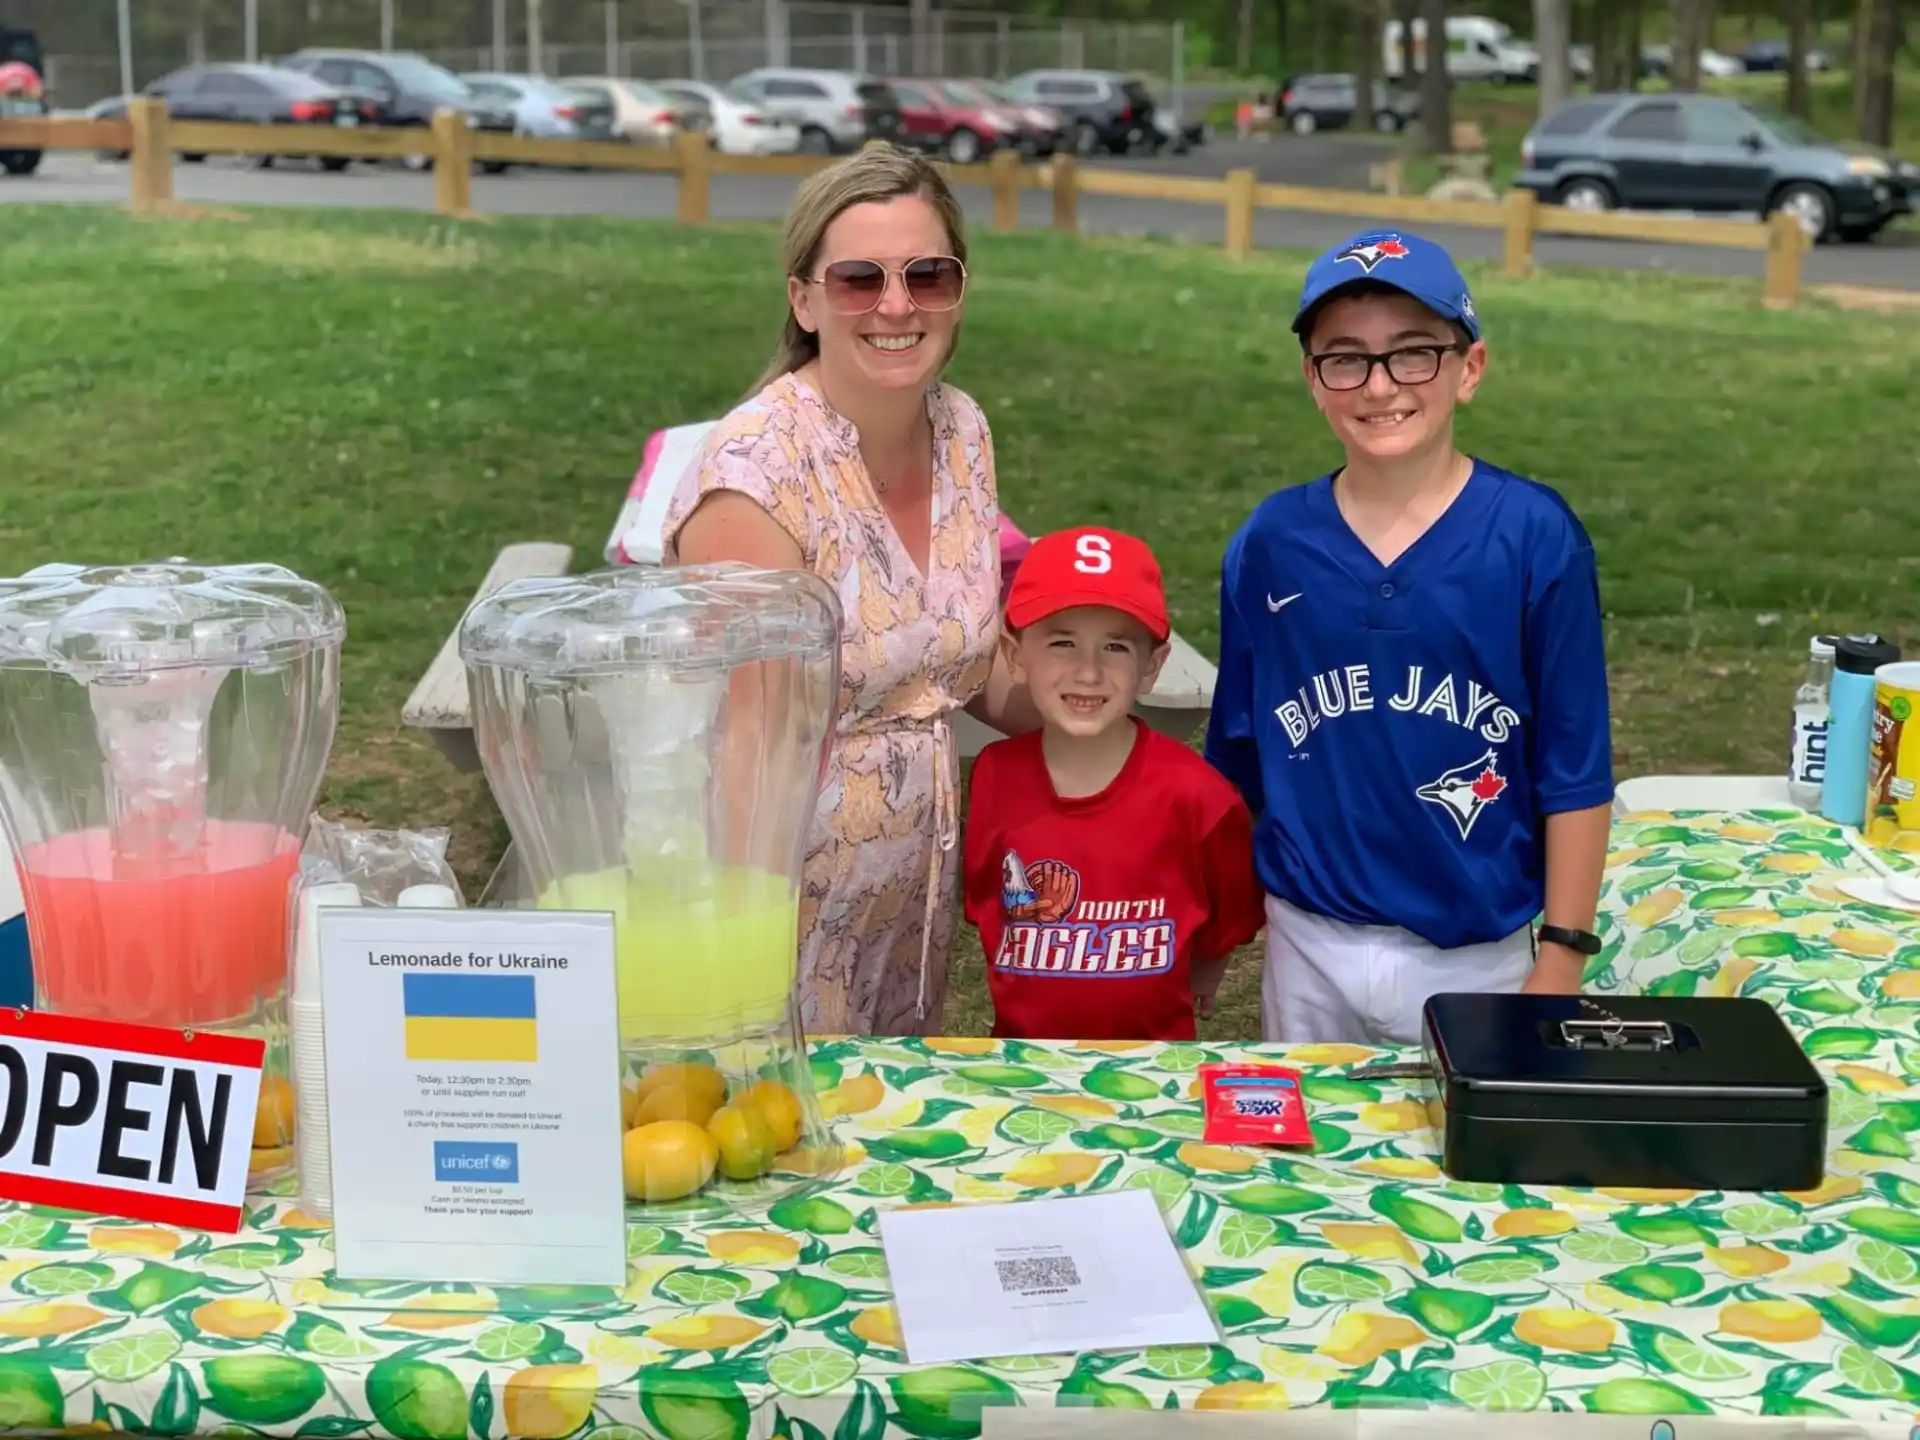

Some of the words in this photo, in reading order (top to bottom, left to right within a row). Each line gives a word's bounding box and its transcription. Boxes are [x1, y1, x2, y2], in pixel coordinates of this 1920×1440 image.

[1074, 535, 1112, 574] S
[1274, 664, 1374, 748] BLUE
[1388, 666, 1520, 743] JAYS
[1800, 719, 1829, 784] hint
[1078, 898, 1165, 920] NORTH
[995, 923, 1171, 973] EAGLES
[368, 951, 463, 967] Lemonade
[468, 952, 493, 968] for
[499, 953, 569, 969] Ukraine
[415, 1074, 444, 1086] Today,
[487, 1076, 496, 1085] to
[498, 1076, 531, 1087] 2:30pm
[433, 1087, 452, 1097] until
[453, 1088, 490, 1098] supplies
[403, 1109, 425, 1118] 100%
[426, 1109, 434, 1118] of
[434, 1110, 470, 1119] proceeds
[472, 1109, 484, 1118] will
[485, 1111, 494, 1119] be
[496, 1111, 527, 1119] donated
[414, 1120, 440, 1129] charity
[456, 1121, 489, 1131] supports
[490, 1122, 521, 1130] children
[522, 1122, 529, 1130] in
[530, 1122, 561, 1131] Ukraine
[441, 1153, 491, 1170] unicef
[452, 1185, 473, 1194] $0.50
[474, 1186, 487, 1195] per
[431, 1195, 452, 1204] Cash
[462, 1196, 489, 1205] Venmo
[491, 1196, 525, 1206] accepted
[424, 1206, 449, 1214] Thank
[450, 1207, 465, 1216] you
[466, 1207, 478, 1215] for
[480, 1208, 498, 1217] your
[499, 1207, 534, 1217] support!
